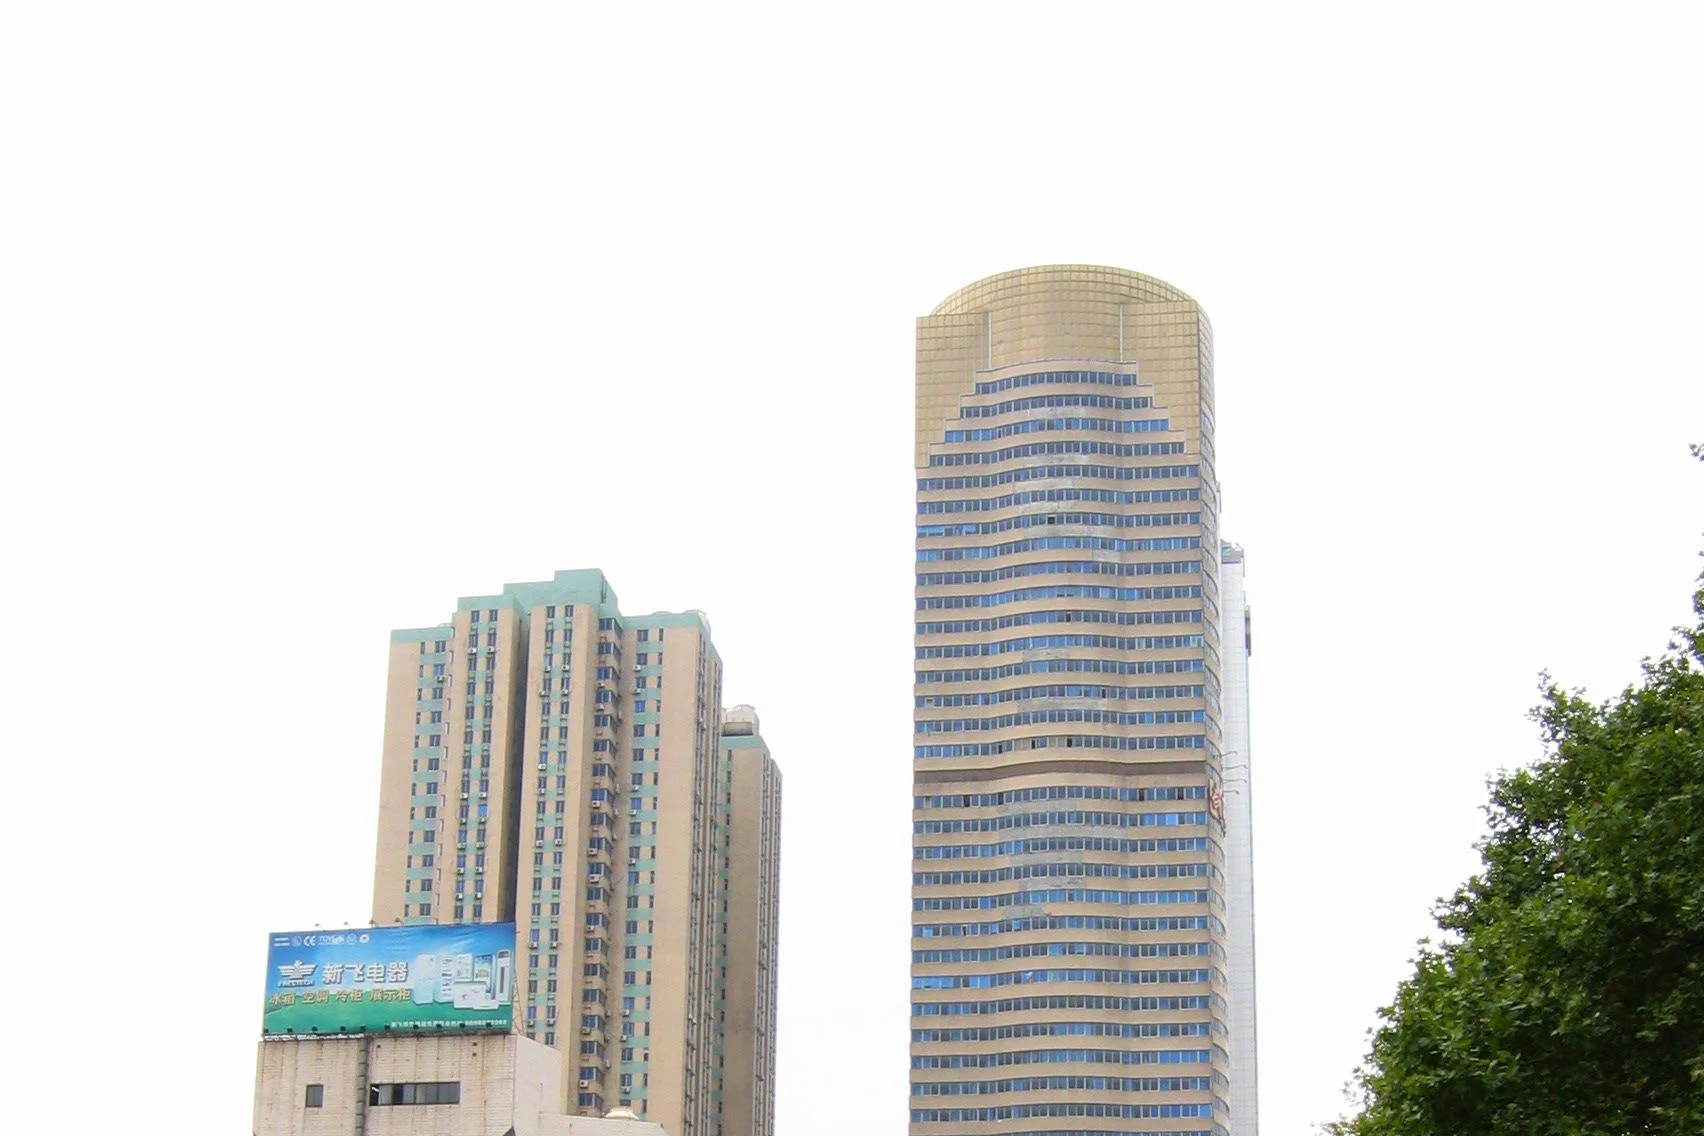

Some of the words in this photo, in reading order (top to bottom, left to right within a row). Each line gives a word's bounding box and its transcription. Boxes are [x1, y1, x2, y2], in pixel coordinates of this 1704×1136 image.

[322, 962, 409, 985] 新飞电器
[269, 991, 296, 1005] 冰箱
[303, 988, 329, 1004] 空调
